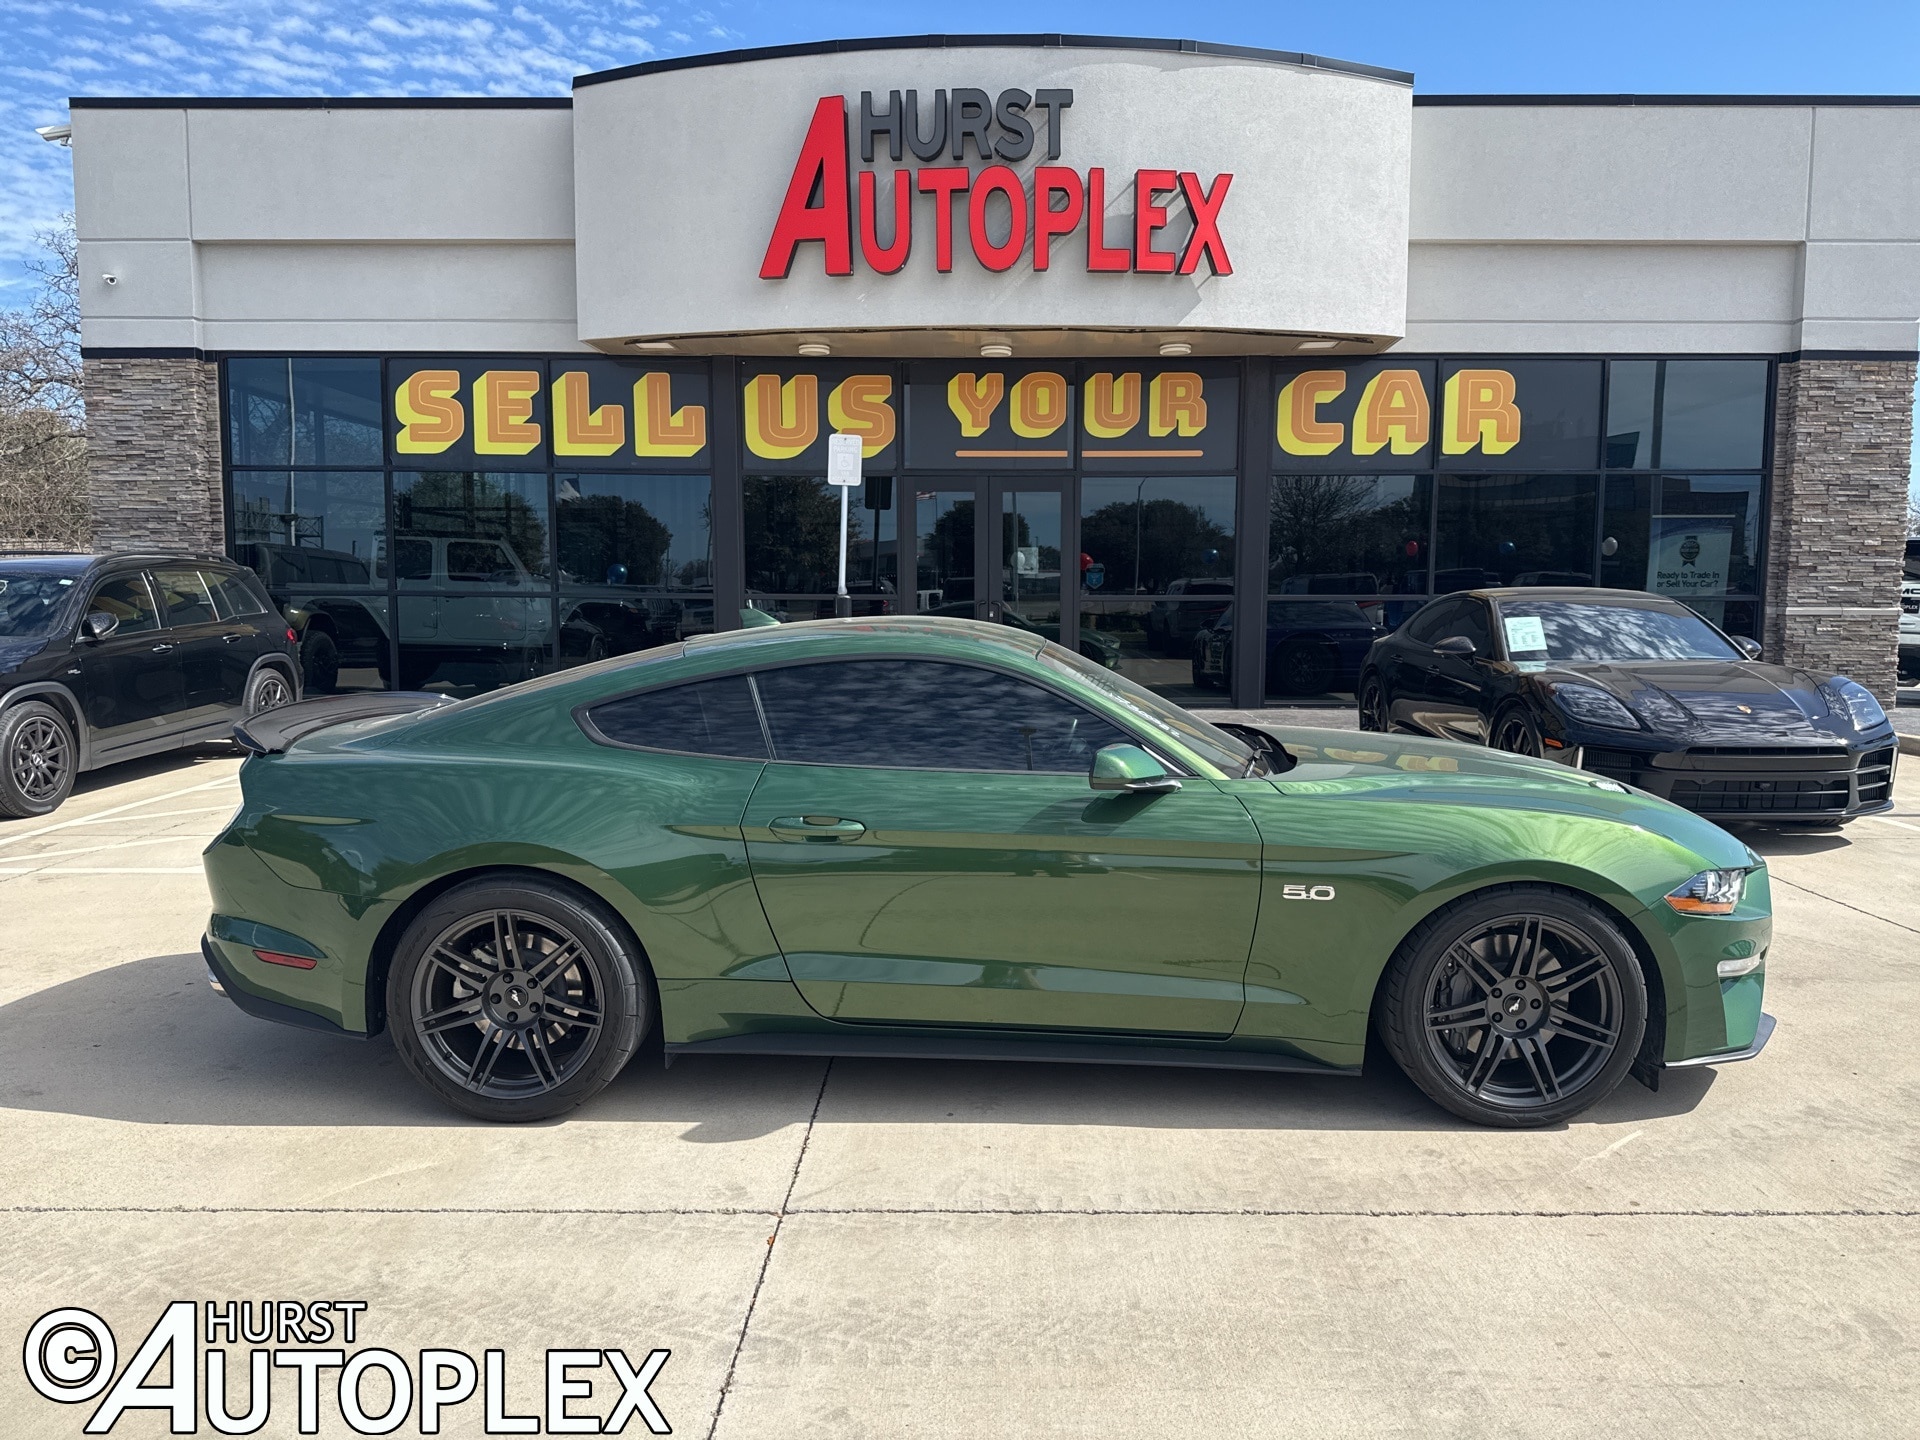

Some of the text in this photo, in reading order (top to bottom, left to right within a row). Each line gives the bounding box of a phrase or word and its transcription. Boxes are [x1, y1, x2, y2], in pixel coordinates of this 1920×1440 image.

[861, 87, 1073, 162] HURST
[759, 95, 1234, 280] AUTOPLEX
[395, 369, 1521, 459] SELL US YOUR CAR
[1657, 571, 1680, 580] Ready
[1681, 571, 1688, 579] to
[1690, 571, 1711, 579] Trade
[1666, 580, 1680, 588] Sell
[1682, 580, 1699, 588] Your
[1700, 580, 1719, 588] Car?
[1282, 884, 1336, 901] 5.0
